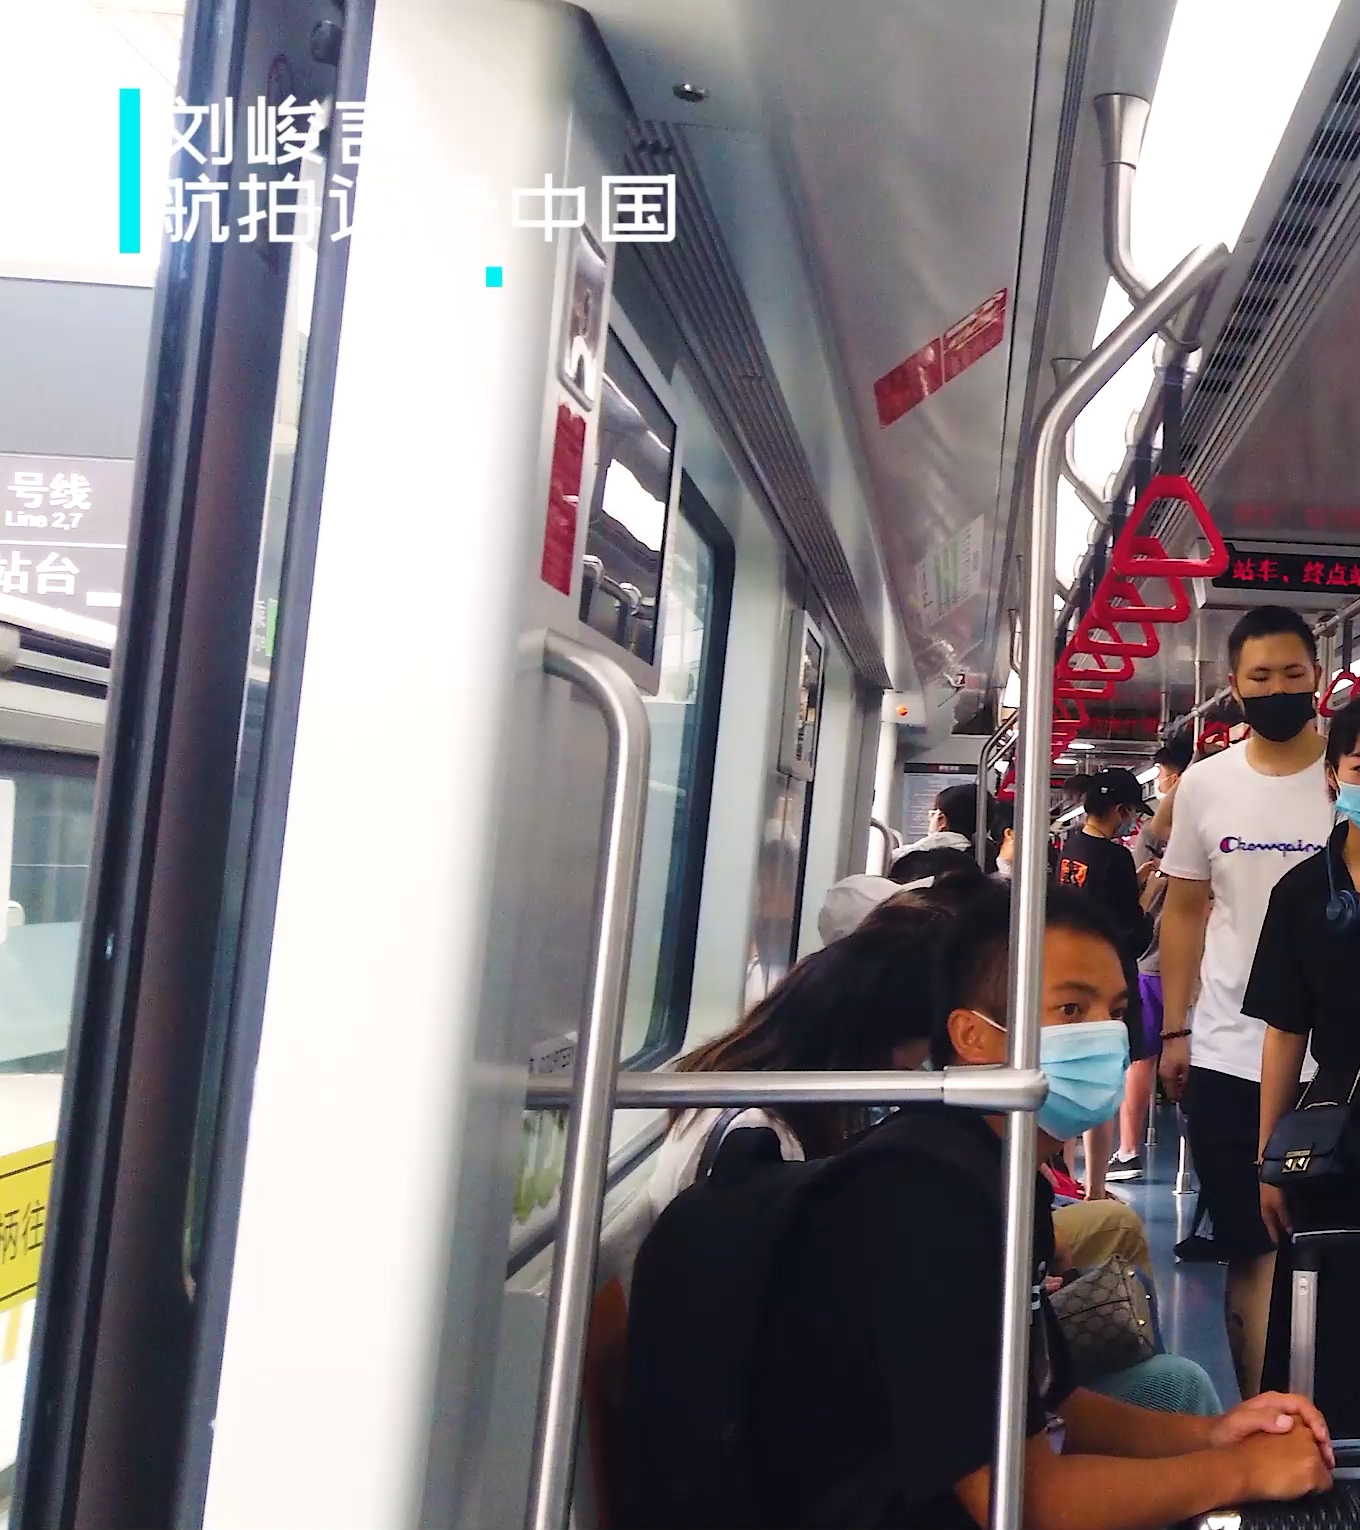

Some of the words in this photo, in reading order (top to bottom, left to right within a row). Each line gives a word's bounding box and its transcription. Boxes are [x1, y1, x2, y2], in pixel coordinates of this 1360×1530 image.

[7, 471, 92, 510] 号线
[5, 510, 48, 527] Line
[51, 512, 83, 531] 2,7
[0, 550, 80, 595] 站台
